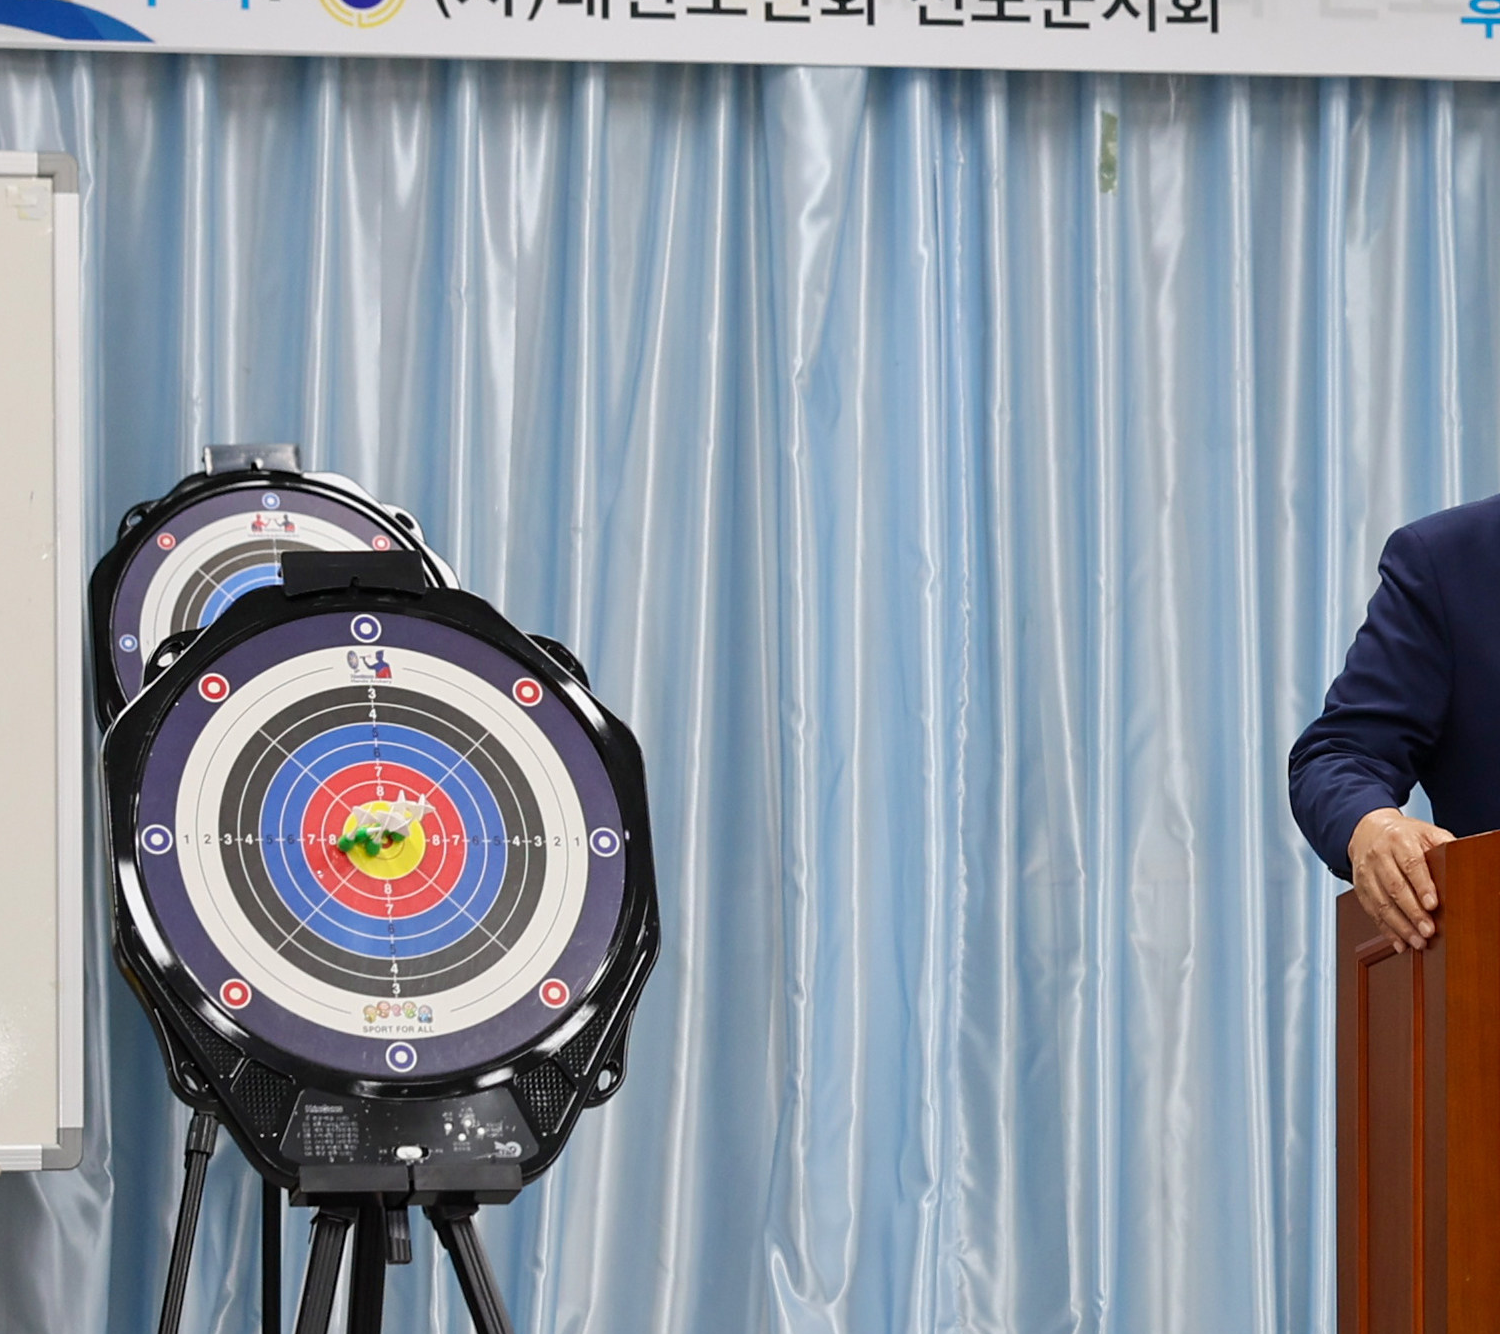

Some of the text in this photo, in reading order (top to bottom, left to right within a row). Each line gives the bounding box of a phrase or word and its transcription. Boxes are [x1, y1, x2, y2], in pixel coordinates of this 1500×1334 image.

[367, 688, 385, 797] 3 4 5 6 7 8
[184, 833, 338, 846] 1 2 3 4 5 6 7 8
[431, 834, 581, 847] 8 7 6 5 4 3 2 1
[383, 883, 401, 995] 8 7 6 5 4 3
[362, 1025, 435, 1034] SPORT FOR ALL
